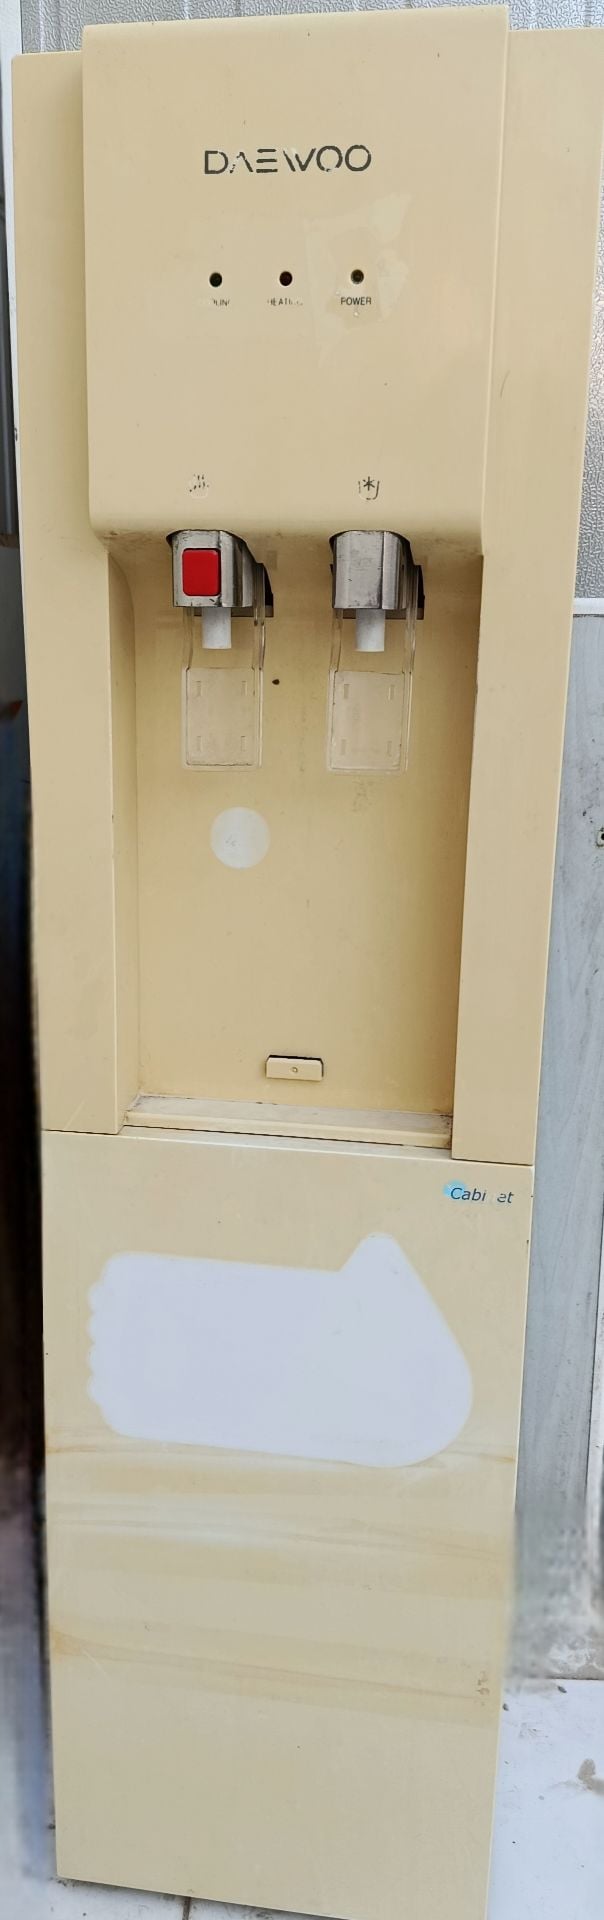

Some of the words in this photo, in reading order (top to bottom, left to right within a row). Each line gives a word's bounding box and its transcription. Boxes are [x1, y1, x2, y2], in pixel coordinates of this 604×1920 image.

[204, 144, 372, 175] DAEWOO
[340, 296, 372, 306] POWER
[450, 1187, 515, 1204] Cabiet
